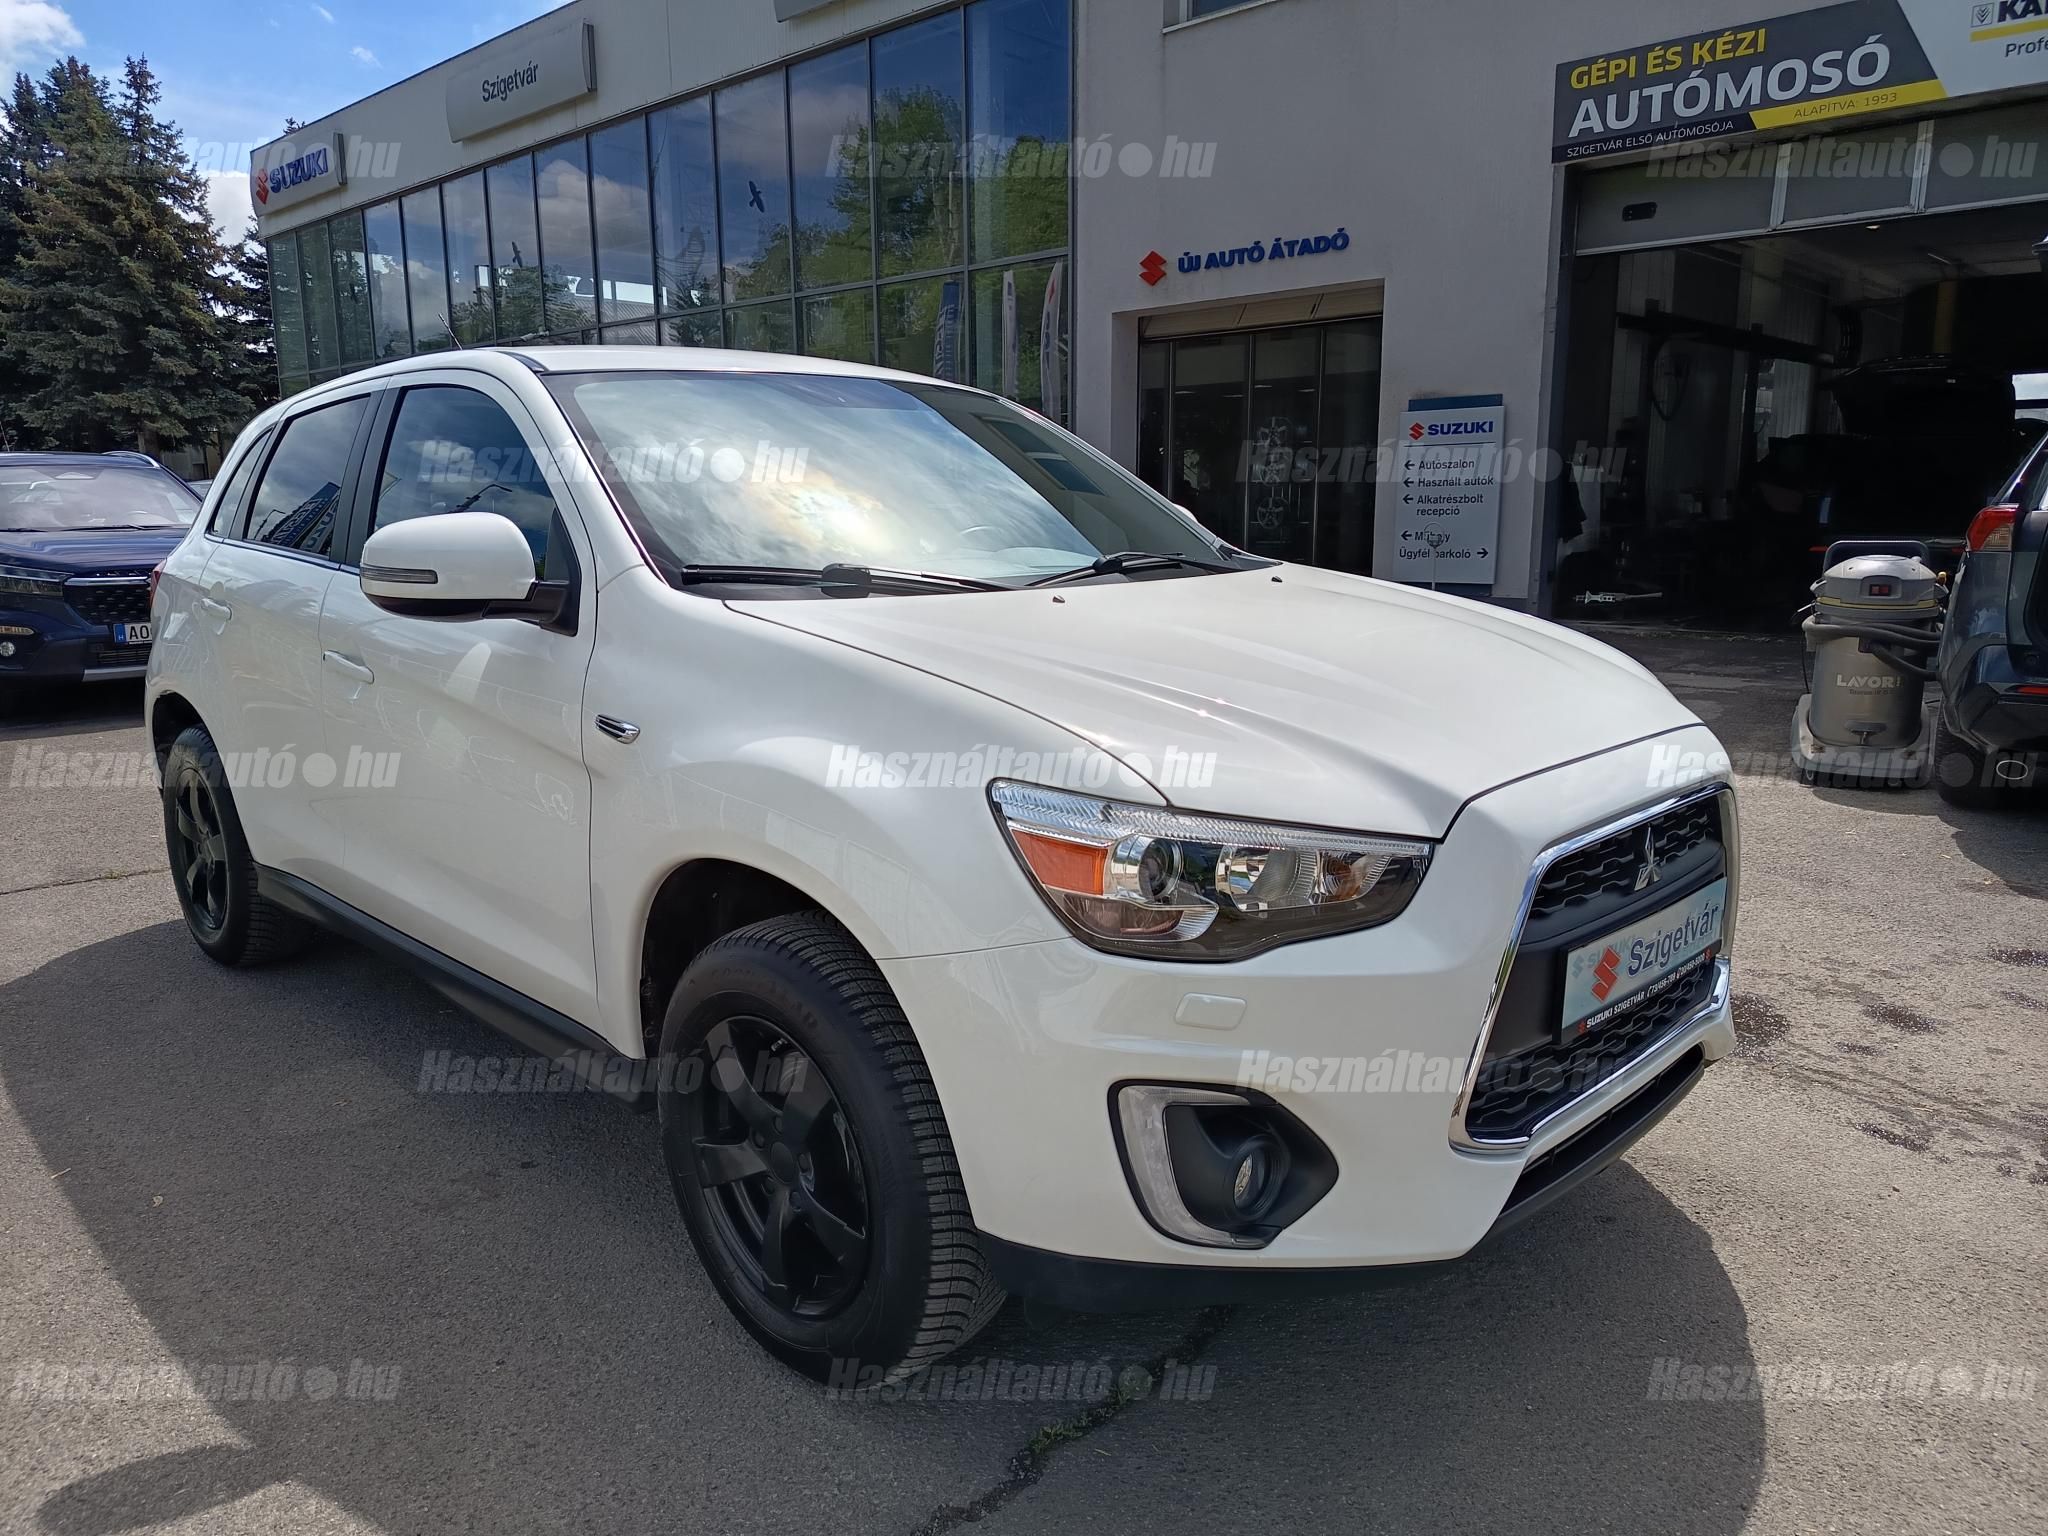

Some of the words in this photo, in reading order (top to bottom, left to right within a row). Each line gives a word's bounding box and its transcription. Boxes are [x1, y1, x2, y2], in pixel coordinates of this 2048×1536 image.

[1570, 55, 1637, 89] GÉPI
[1646, 45, 1682, 75] ÉS
[1692, 28, 1766, 66] KÉZI
[481, 60, 539, 103] Szigetvár
[1568, 33, 1890, 138] AUTÓMOSÓ
[1864, 92, 1897, 107] 1993
[1567, 139, 1623, 158] SZIGETVÁR
[1655, 119, 1734, 142] AUTÓMOSÓJA
[269, 147, 329, 194] SUZUKI
[1178, 251, 1201, 273] ÚJ
[1204, 240, 1265, 270] AUTÓ
[1268, 227, 1350, 260] ÁTADÓ
[1427, 420, 1494, 436] SUZUKI
[1417, 477, 1461, 488] Használt
[1464, 475, 1494, 486] autók
[1418, 459, 1475, 470] Autószalon
[1416, 494, 1484, 505] Alkatrészbolt
[1416, 505, 1460, 517] recepció
[1399, 545, 1430, 560] Ügyfél
[1628, 902, 1719, 976] Szigetvár
[1586, 1007, 1614, 1029] SUZUKI
[1613, 990, 1645, 1014] SZIGETVÁR
